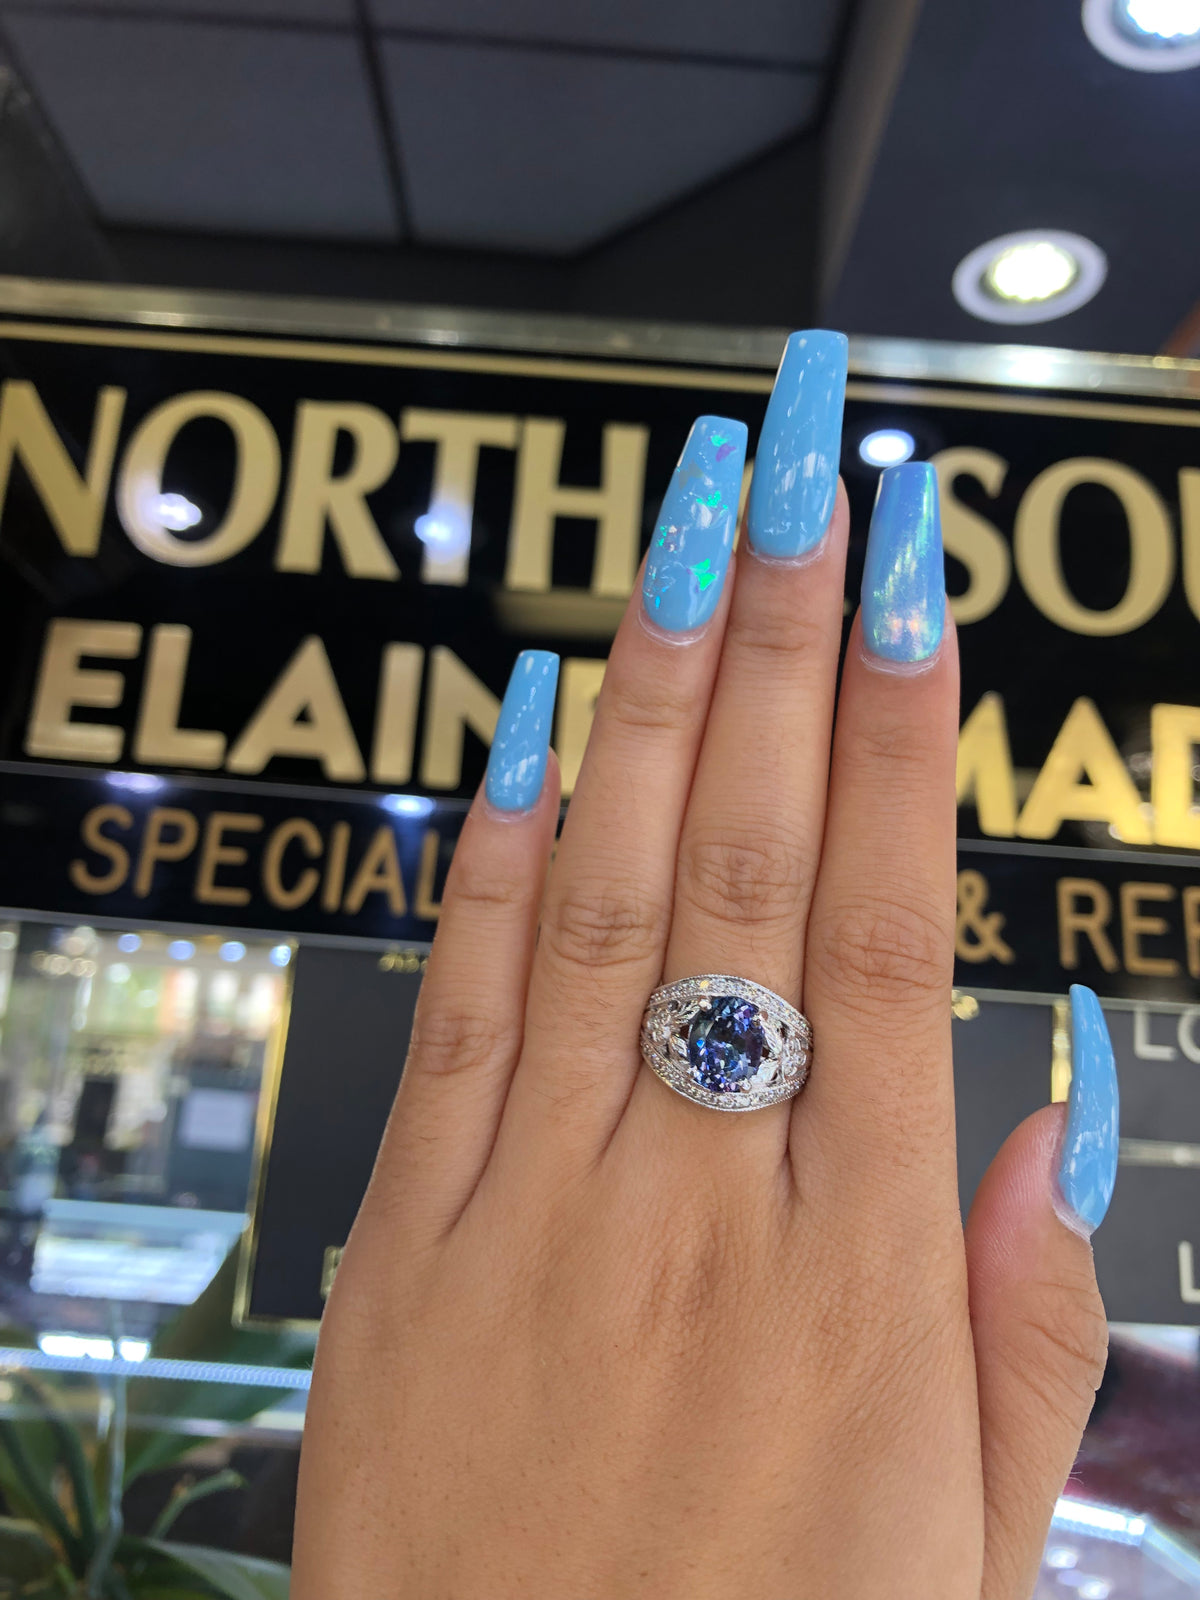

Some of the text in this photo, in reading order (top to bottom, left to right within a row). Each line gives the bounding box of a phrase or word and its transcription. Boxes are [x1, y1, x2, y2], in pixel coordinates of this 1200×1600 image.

[0, 379, 649, 595] NORTH
[929, 447, 1200, 636] SO
[1056, 876, 1200, 979] RE
